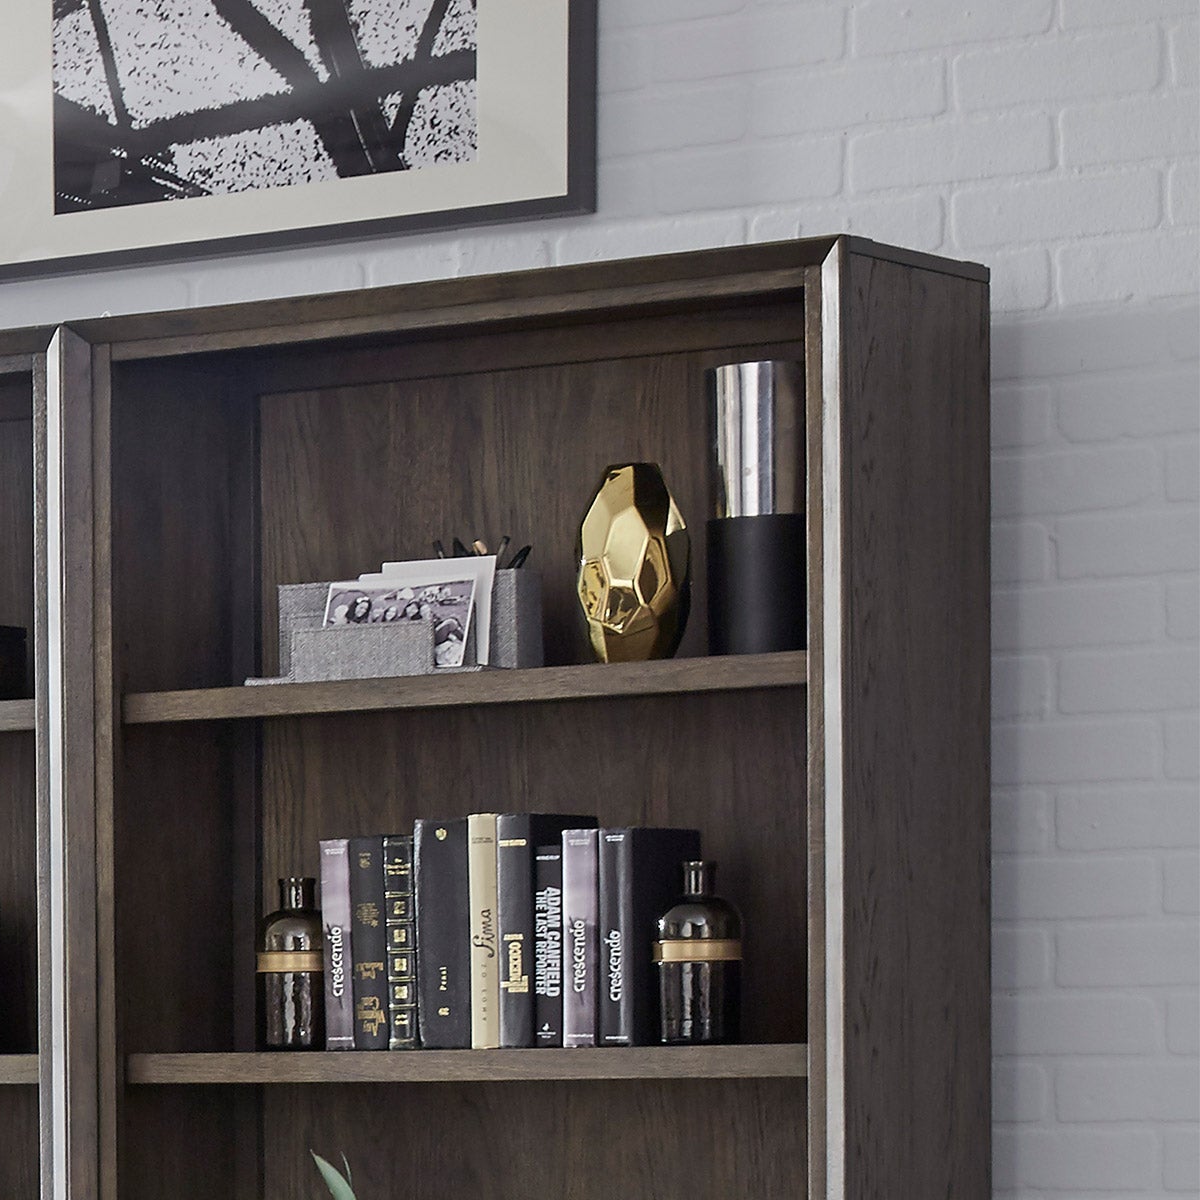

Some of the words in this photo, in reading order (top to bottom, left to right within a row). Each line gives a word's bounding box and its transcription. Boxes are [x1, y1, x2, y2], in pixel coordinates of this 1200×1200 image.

[536, 890, 548, 911] THE
[536, 913, 548, 938] LAST
[546, 886, 560, 928] ADAM
[326, 926, 344, 997] crescendo
[536, 941, 547, 995] REPORTER
[546, 930, 560, 997] CANFIELD
[568, 920, 586, 993] crescendo
[604, 930, 622, 1002] crescendo
